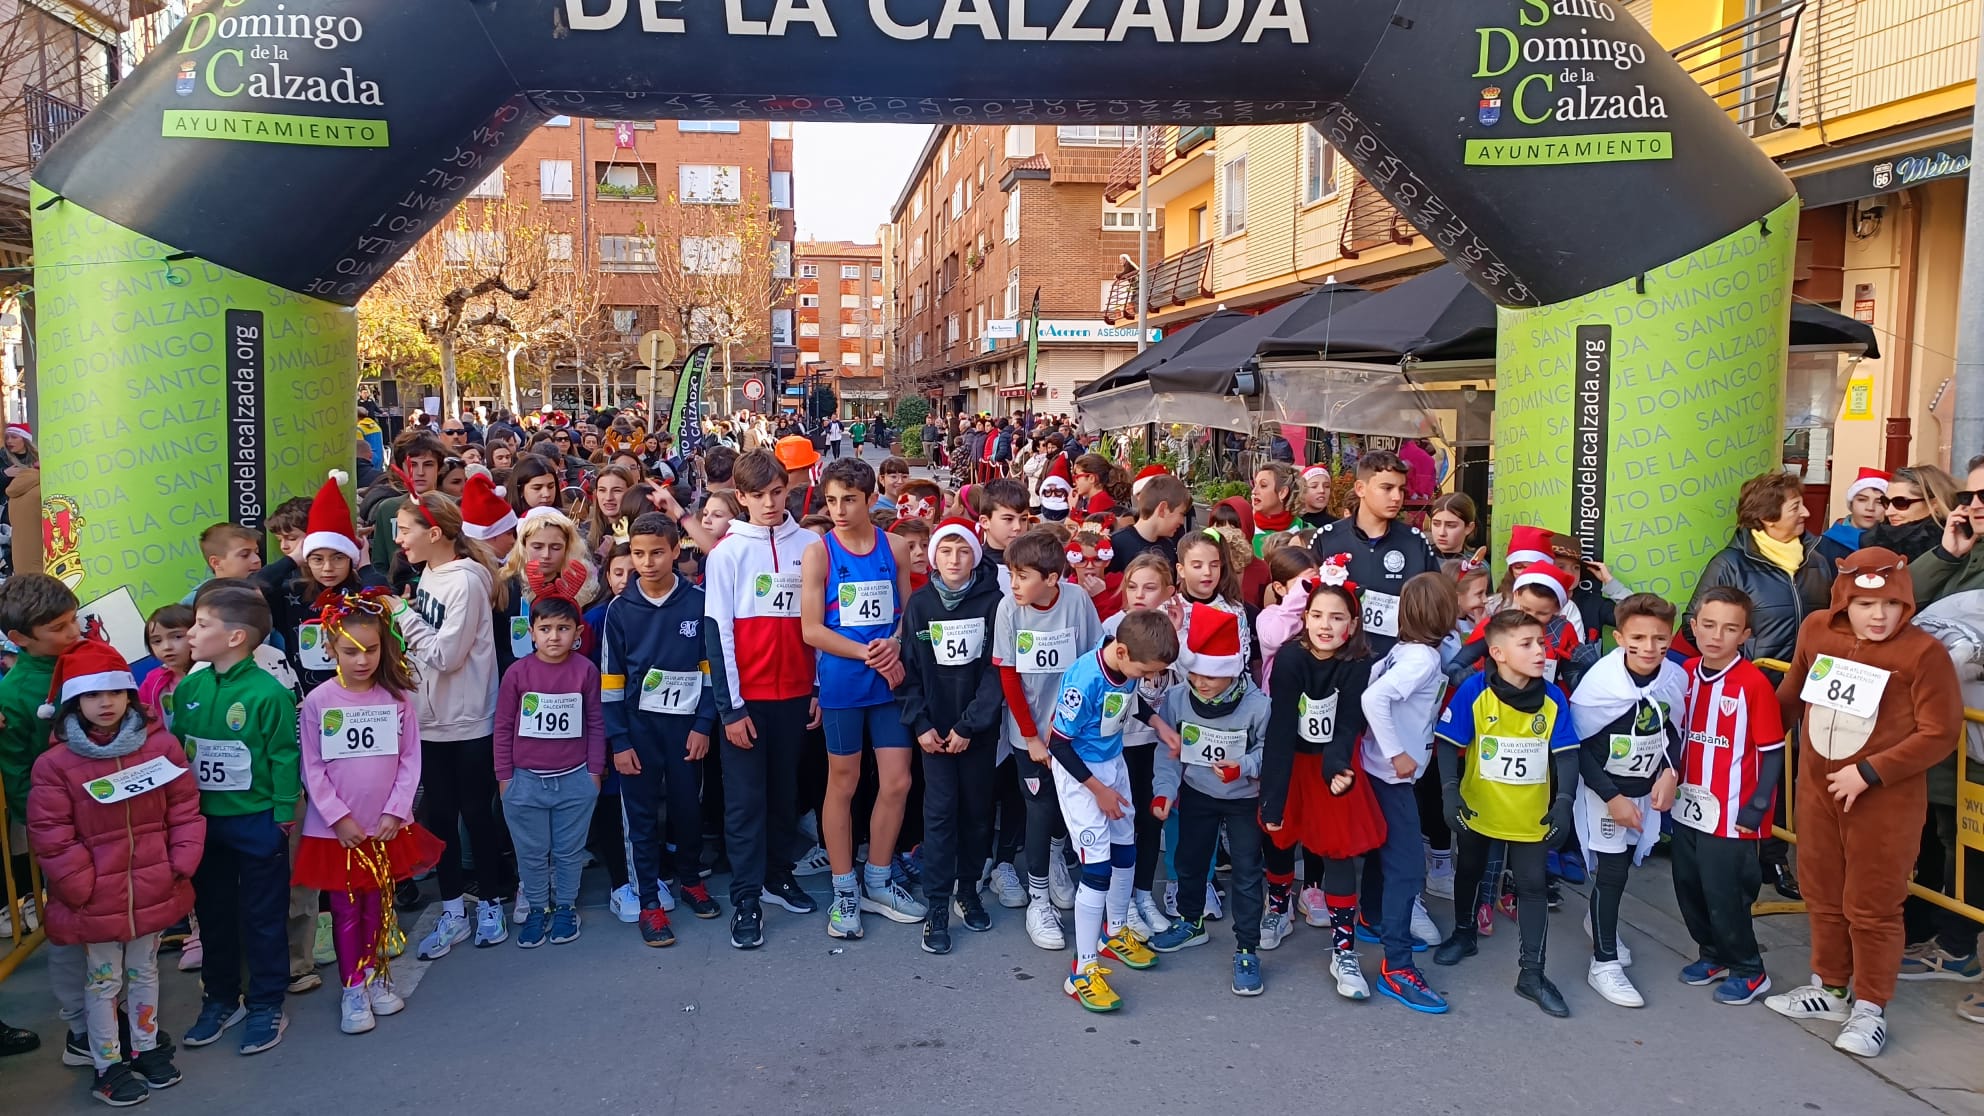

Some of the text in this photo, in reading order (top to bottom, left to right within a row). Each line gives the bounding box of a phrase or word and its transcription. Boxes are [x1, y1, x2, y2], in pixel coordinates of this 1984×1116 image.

[177, 4, 363, 54] Domingo
[567, 0, 1310, 44] DE LA CALZADA
[250, 45, 289, 60] de la
[1472, 28, 1646, 78] Domingo
[205, 49, 385, 106] Calzada
[1560, 68, 1596, 83] de la
[1512, 73, 1668, 125] Calzada
[176, 116, 376, 141] AYUNTAMIENTO
[1478, 139, 1662, 160] AYUNTAMIENTO
[1876, 172, 1889, 186] 66
[1896, 151, 1974, 185] Metro
[99, 265, 194, 303] SANTO
[1614, 270, 1751, 327] DOMINGO
[1097, 327, 1140, 338] ASESORIA
[1674, 300, 1754, 343] SANTO
[73, 331, 214, 380] DOMINGO
[1646, 359, 1679, 383] LA
[1685, 322, 1777, 371] CALZADA
[1636, 360, 1763, 416] DOMINGO
[1695, 390, 1766, 432] SANTO
[1369, 436, 1396, 451] METRO
[1668, 447, 1699, 471] LA
[1658, 449, 1771, 504] DOMINGO
[127, 512, 162, 536] LA
[1688, 535, 1718, 557] LA
[773, 591, 794, 612] 47
[859, 599, 881, 619] 45
[1363, 607, 1384, 628] 86
[946, 638, 969, 659] 54
[1036, 648, 1059, 668] 60
[661, 687, 682, 708] 11
[1826, 678, 1856, 706] 84
[533, 711, 570, 732] 196
[1308, 716, 1332, 737] 80
[346, 727, 374, 750] 96
[1687, 730, 1730, 748] xabank
[1201, 744, 1226, 762] 49
[1628, 752, 1656, 772] 27
[198, 760, 227, 783] 55
[1501, 756, 1527, 778] 75
[124, 776, 156, 793] 87
[1684, 797, 1703, 822] 73
